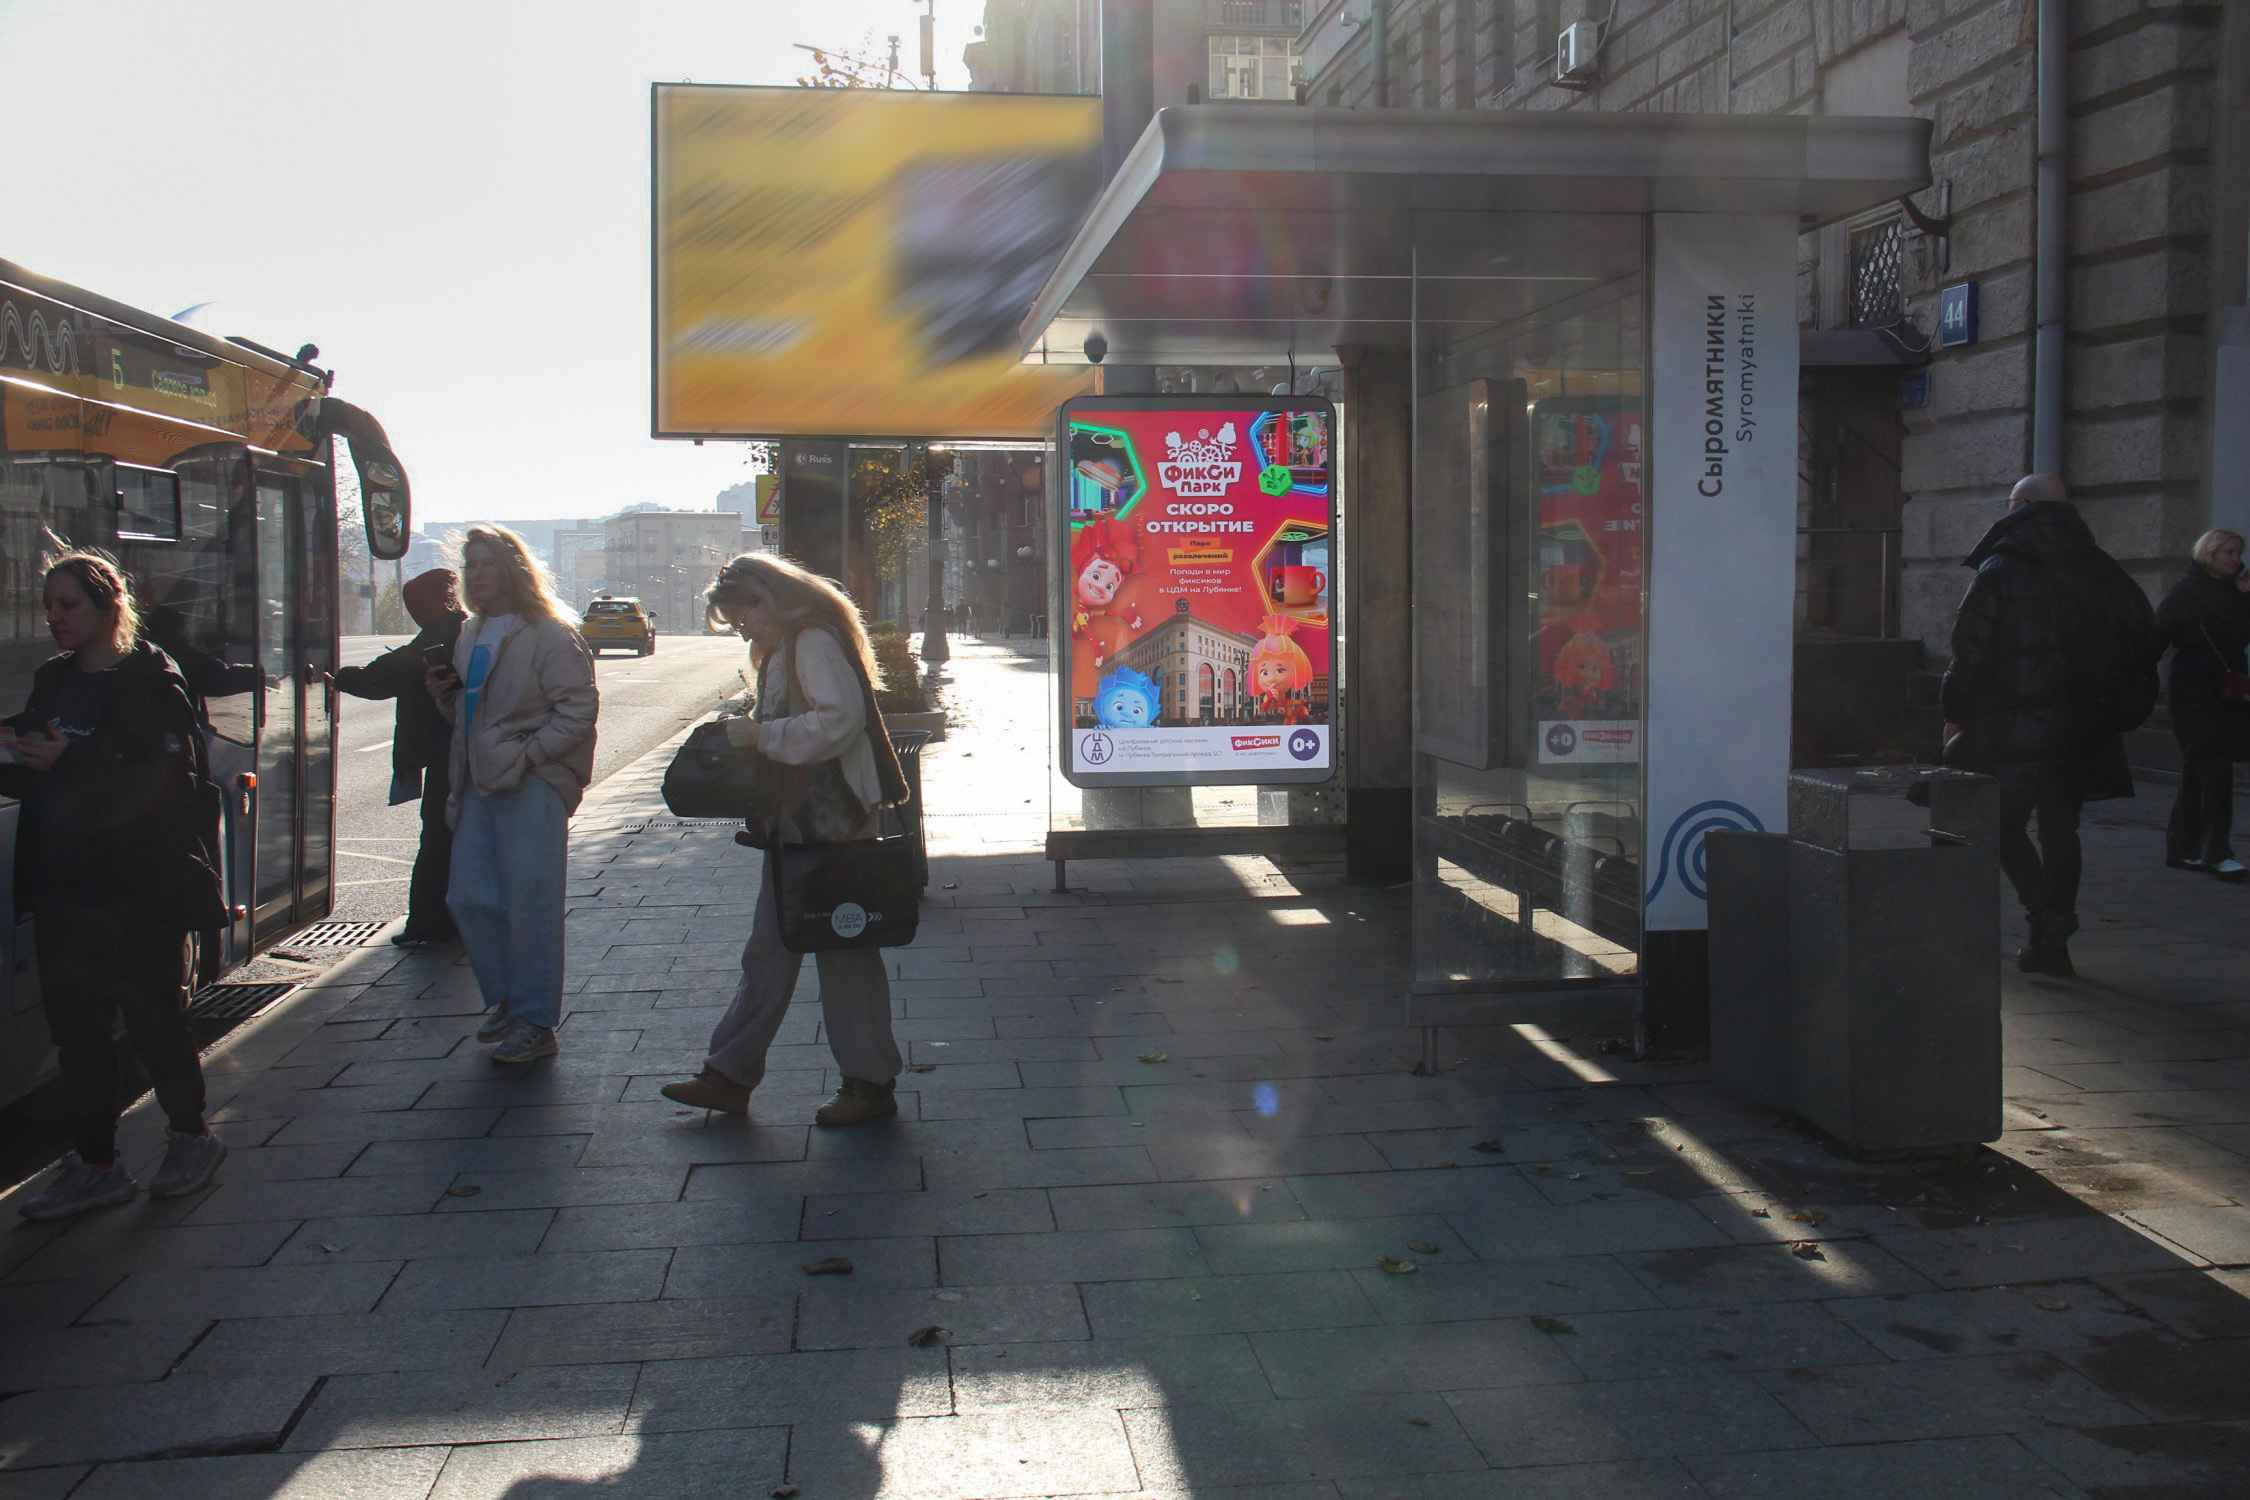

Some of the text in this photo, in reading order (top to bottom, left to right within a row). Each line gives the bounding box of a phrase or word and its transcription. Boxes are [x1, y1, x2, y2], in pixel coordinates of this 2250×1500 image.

[1944, 300, 1964, 330] 44
[1736, 294, 1758, 442] Syromyatniki
[1698, 295, 1729, 497] Сыромятники
[1166, 503, 1234, 515] СКОРО
[1146, 521, 1254, 533] ОТКРЫТИЕ
[1173, 552, 1229, 560] развлечений
[1203, 586, 1242, 595] Лубянке!
[1293, 738, 1316, 752] 0+
[835, 913, 863, 924] MBA
